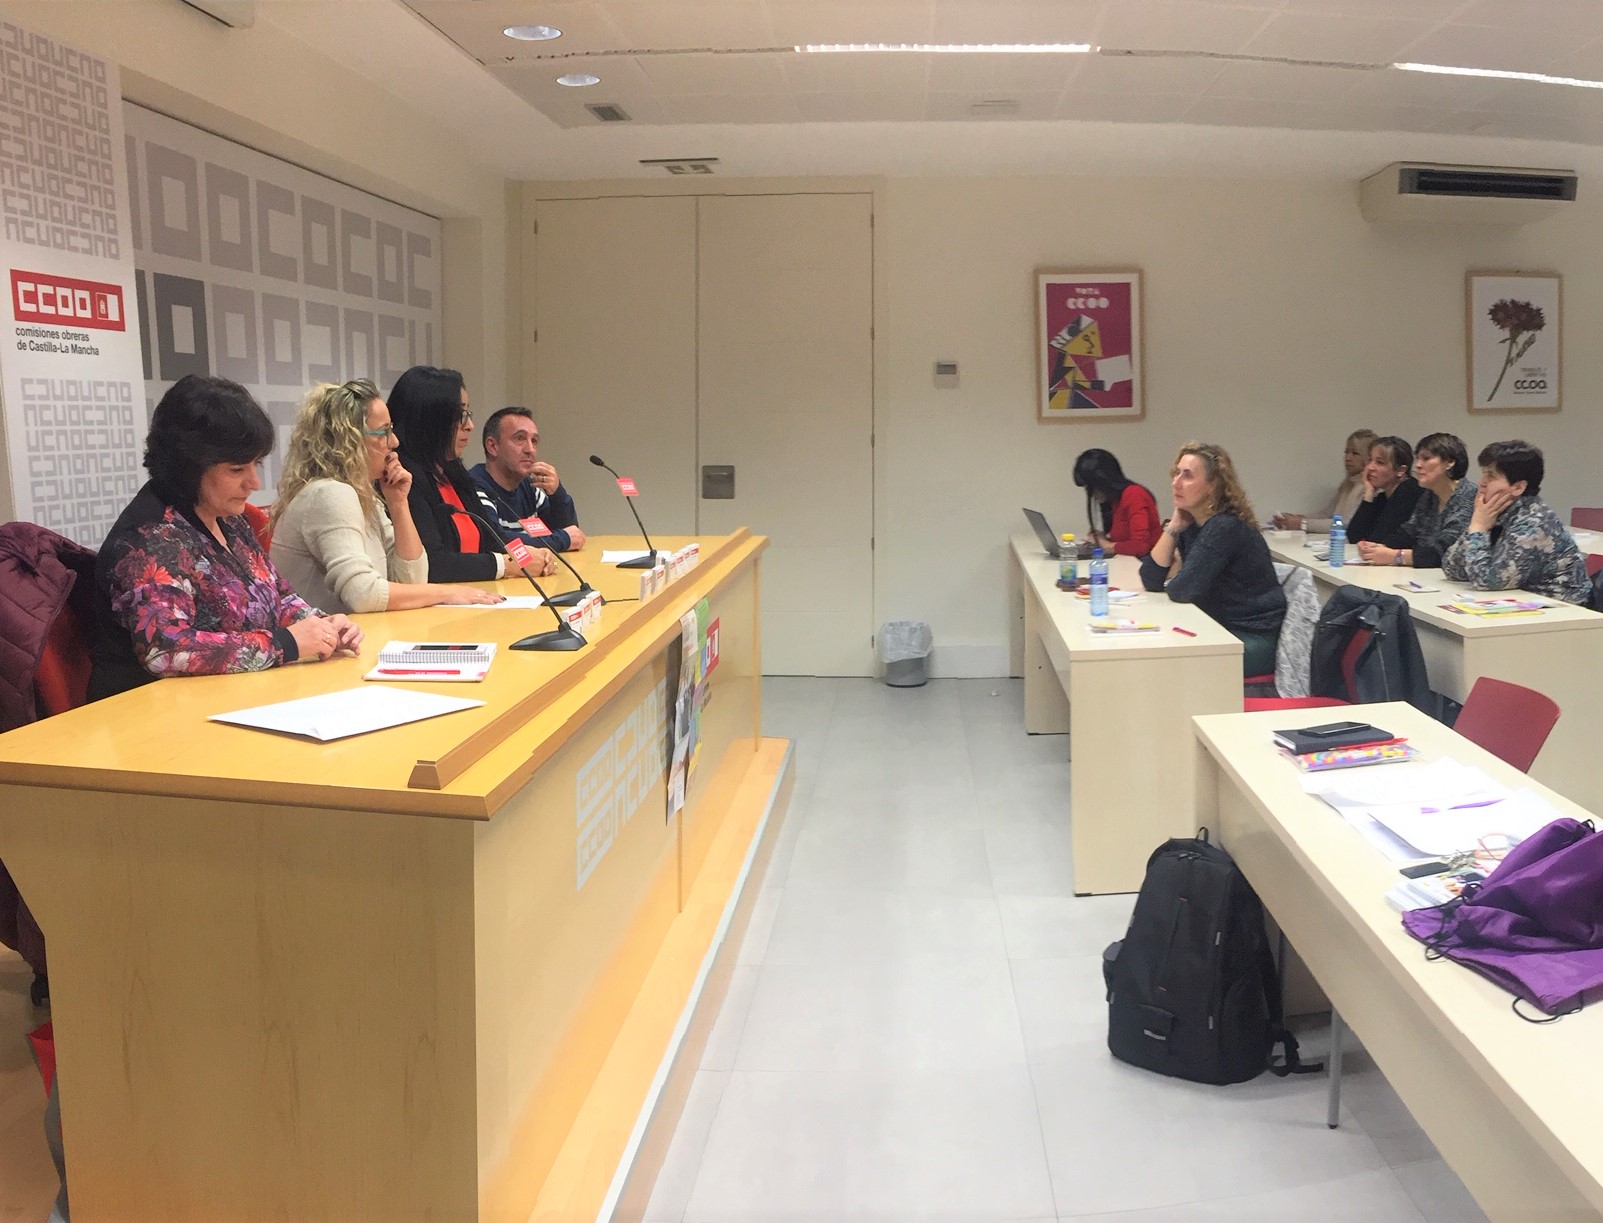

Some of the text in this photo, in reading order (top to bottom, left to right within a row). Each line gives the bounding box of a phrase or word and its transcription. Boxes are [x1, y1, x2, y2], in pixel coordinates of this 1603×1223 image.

[17, 281, 92, 319] CCOO
[15, 326, 90, 342] comisiones obreras
[16, 340, 100, 356] de Castilla-La Mancha
